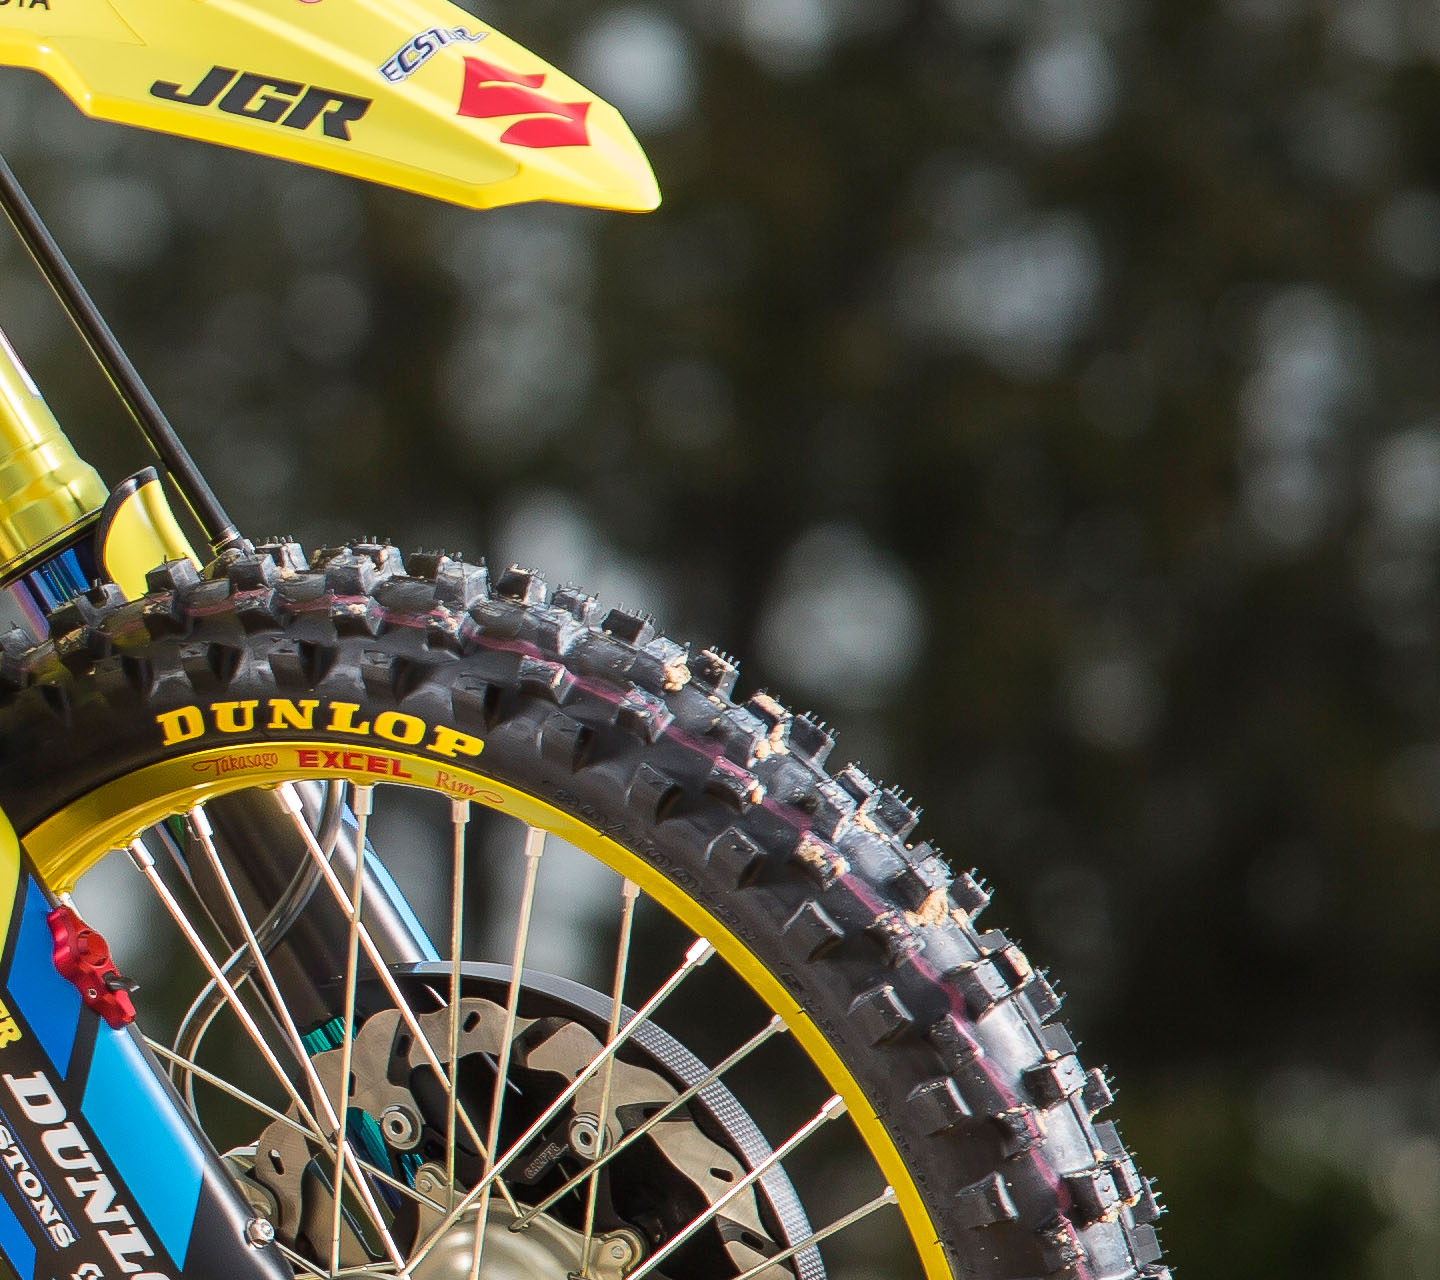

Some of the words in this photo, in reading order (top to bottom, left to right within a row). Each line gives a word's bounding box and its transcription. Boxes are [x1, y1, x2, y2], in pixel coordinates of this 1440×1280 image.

[149, 66, 373, 141] JGR
[155, 698, 485, 758] DUNLOP
[192, 752, 279, 777] Takasago
[296, 749, 413, 779] EXCEL
[436, 770, 505, 805] Rim
